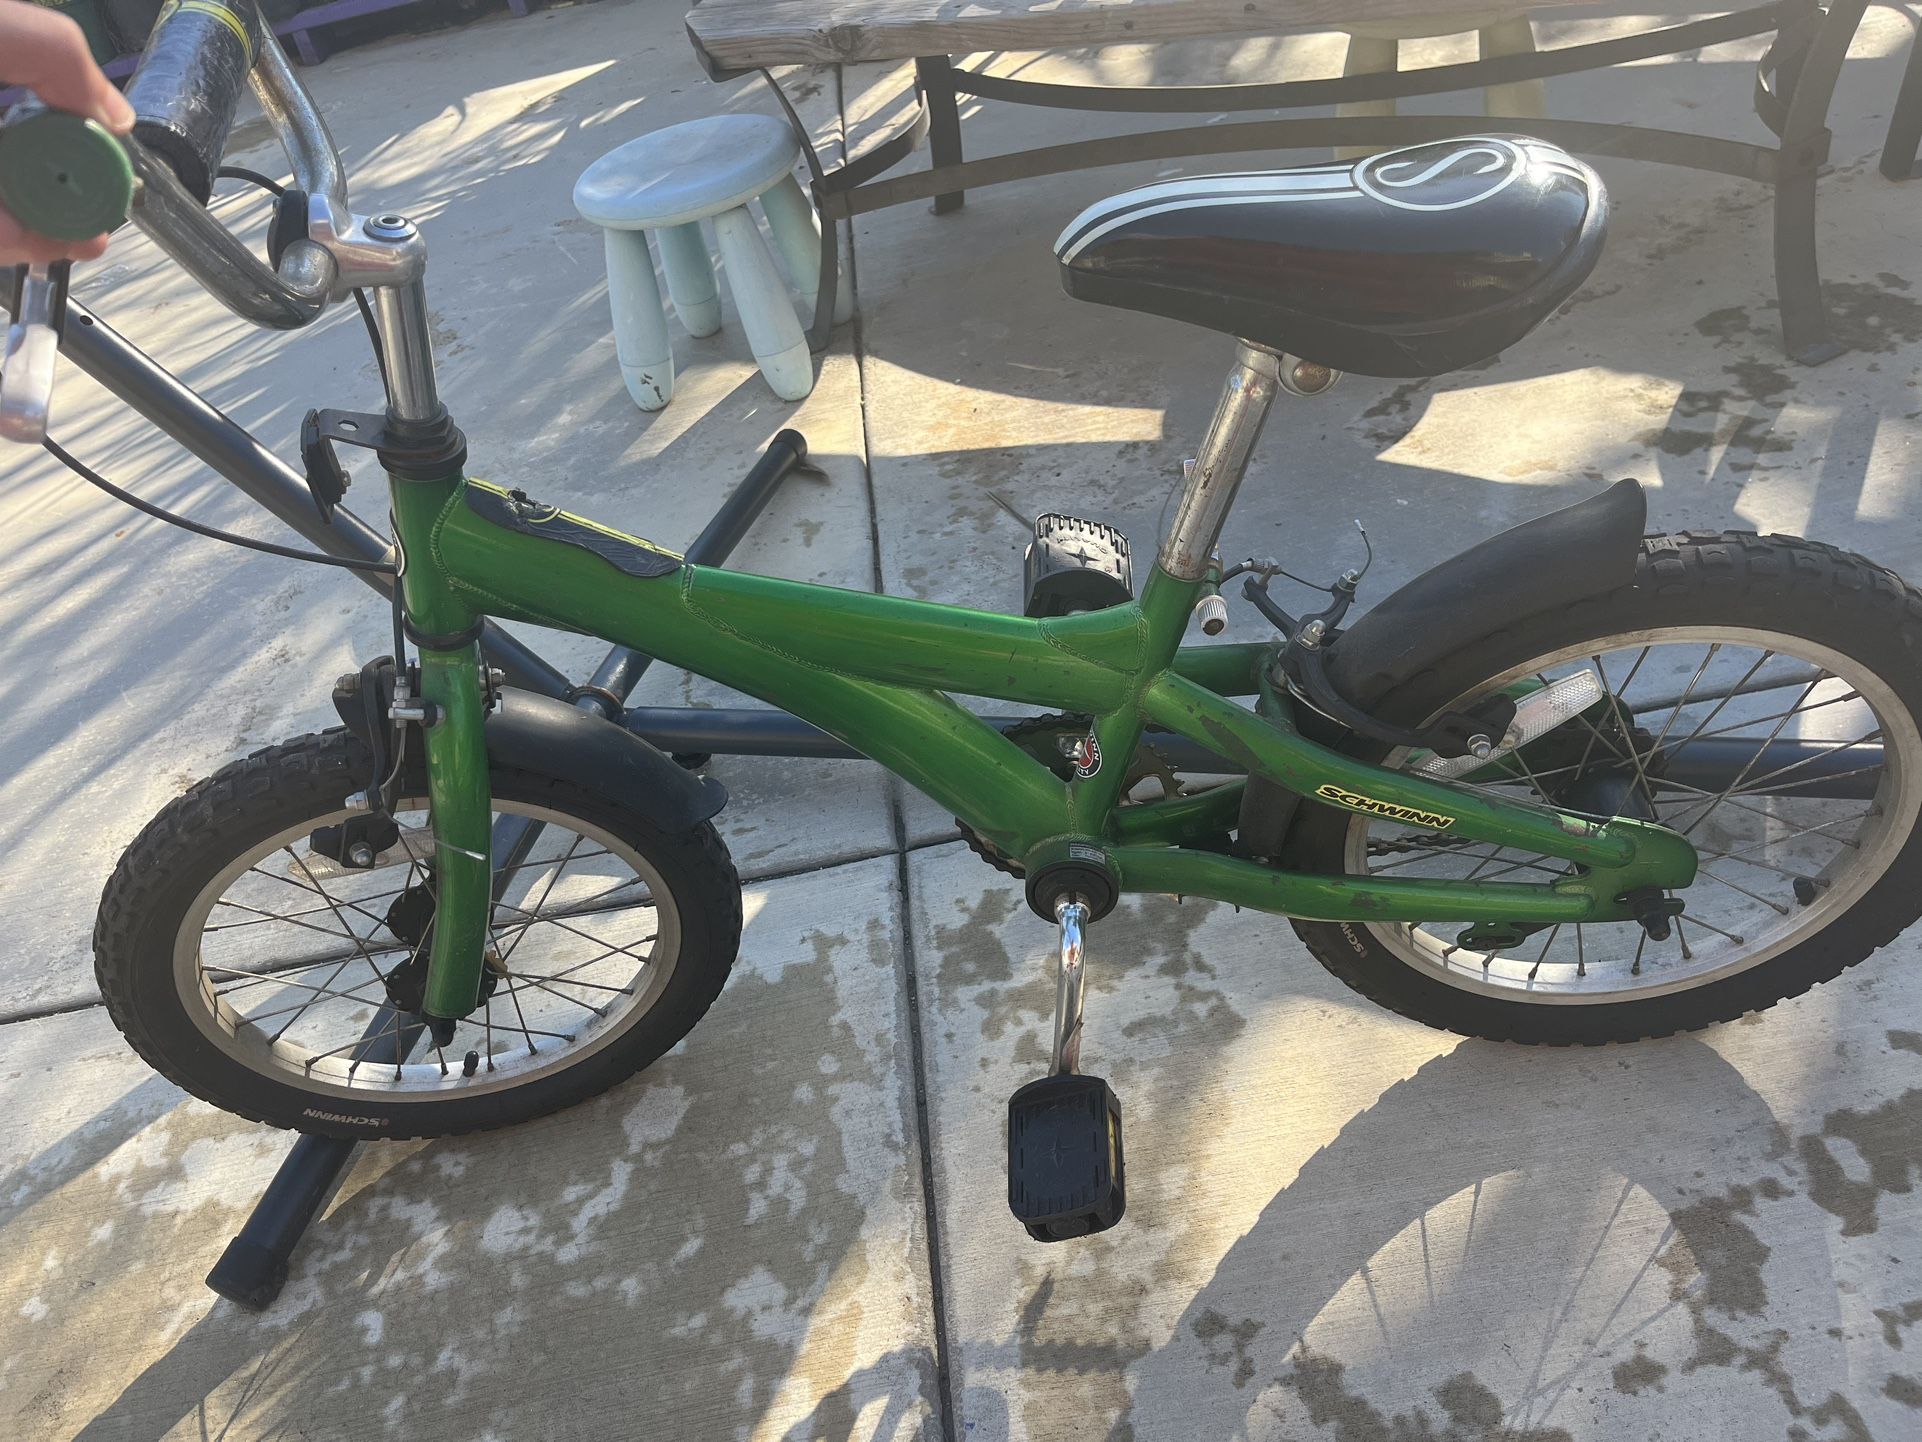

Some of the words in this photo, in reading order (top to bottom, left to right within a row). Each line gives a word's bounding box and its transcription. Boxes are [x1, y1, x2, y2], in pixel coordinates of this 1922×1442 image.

[1318, 785, 1454, 828] SCHWINN
[1340, 922, 1365, 953] SCHW
[303, 1107, 380, 1127] SCHWINN
